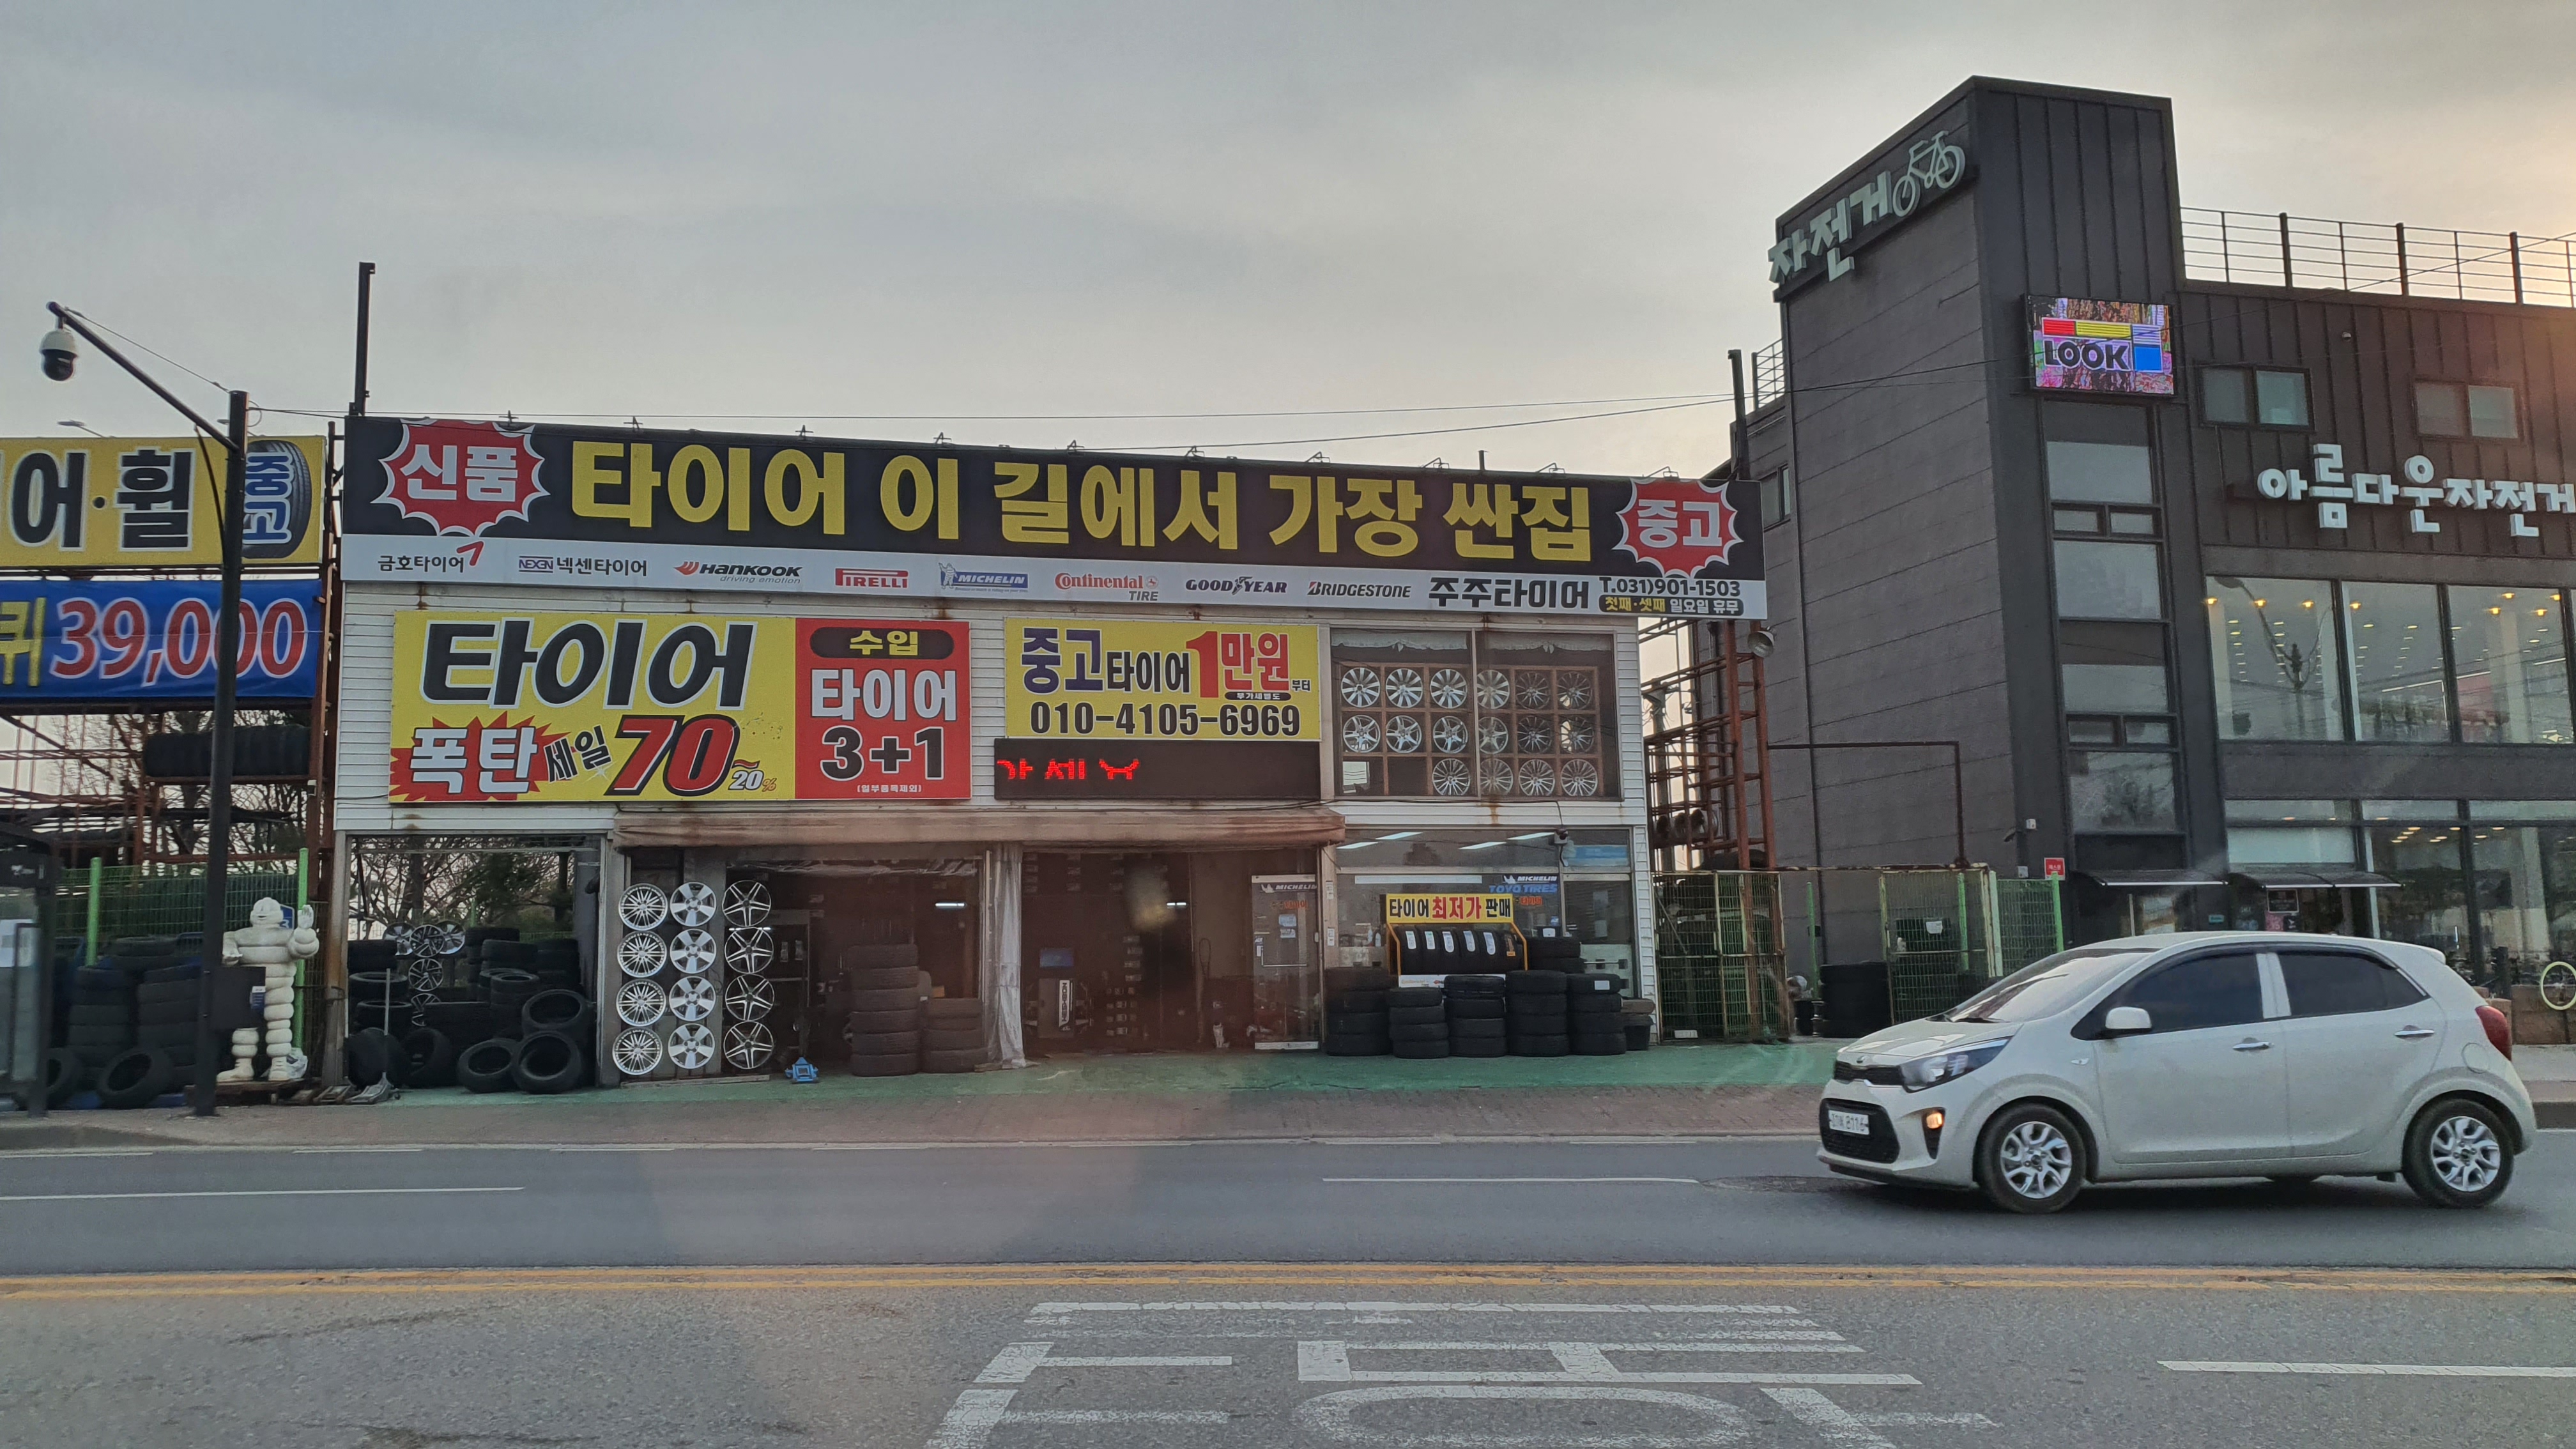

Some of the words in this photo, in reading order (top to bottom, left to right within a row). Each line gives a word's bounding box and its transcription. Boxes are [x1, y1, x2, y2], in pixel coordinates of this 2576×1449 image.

[1768, 171, 1892, 281] 자전거
[2044, 339, 2131, 371] LOOK
[400, 443, 518, 503] 신품
[241, 452, 292, 544] 중고
[572, 441, 845, 535] 타이어
[880, 454, 958, 540] 이
[994, 461, 1238, 550] 길에서
[1269, 475, 1423, 558] 가장
[1443, 482, 1591, 562] 싼집
[1637, 498, 1723, 548] 중고
[378, 555, 464, 573] 금호타이어
[519, 558, 554, 571] NEXEN
[556, 557, 647, 576] 넥센타이어
[835, 568, 908, 588] PIRELLI
[958, 574, 1025, 584] MICHELIN
[1055, 572, 1144, 590] Continental
[1185, 576, 1287, 595] GOODYEAR
[1307, 581, 1412, 598] BRIDGESTONE
[1599, 577, 1741, 597] T.031)901-1503
[1128, 590, 1159, 601] TIRE
[1429, 576, 1589, 609] 주주타이어
[1669, 599, 1709, 613] 일요일
[1713, 600, 1739, 614] 휴무
[50, 596, 307, 687] 39,000
[850, 630, 918, 656] 수입
[421, 617, 758, 710] 타이어
[811, 668, 956, 721] 타이어
[1030, 701, 1301, 737] 010-4105-6969
[409, 726, 538, 794] 폭탄
[544, 725, 614, 783] 세일
[820, 724, 944, 781] 3+1
[1489, 884, 1521, 893] TOYO
[1523, 883, 1558, 893] TIRES
[1389, 898, 1429, 917] 타이어
[1432, 896, 1482, 920] 최저가
[1485, 898, 1511, 917] 판매
